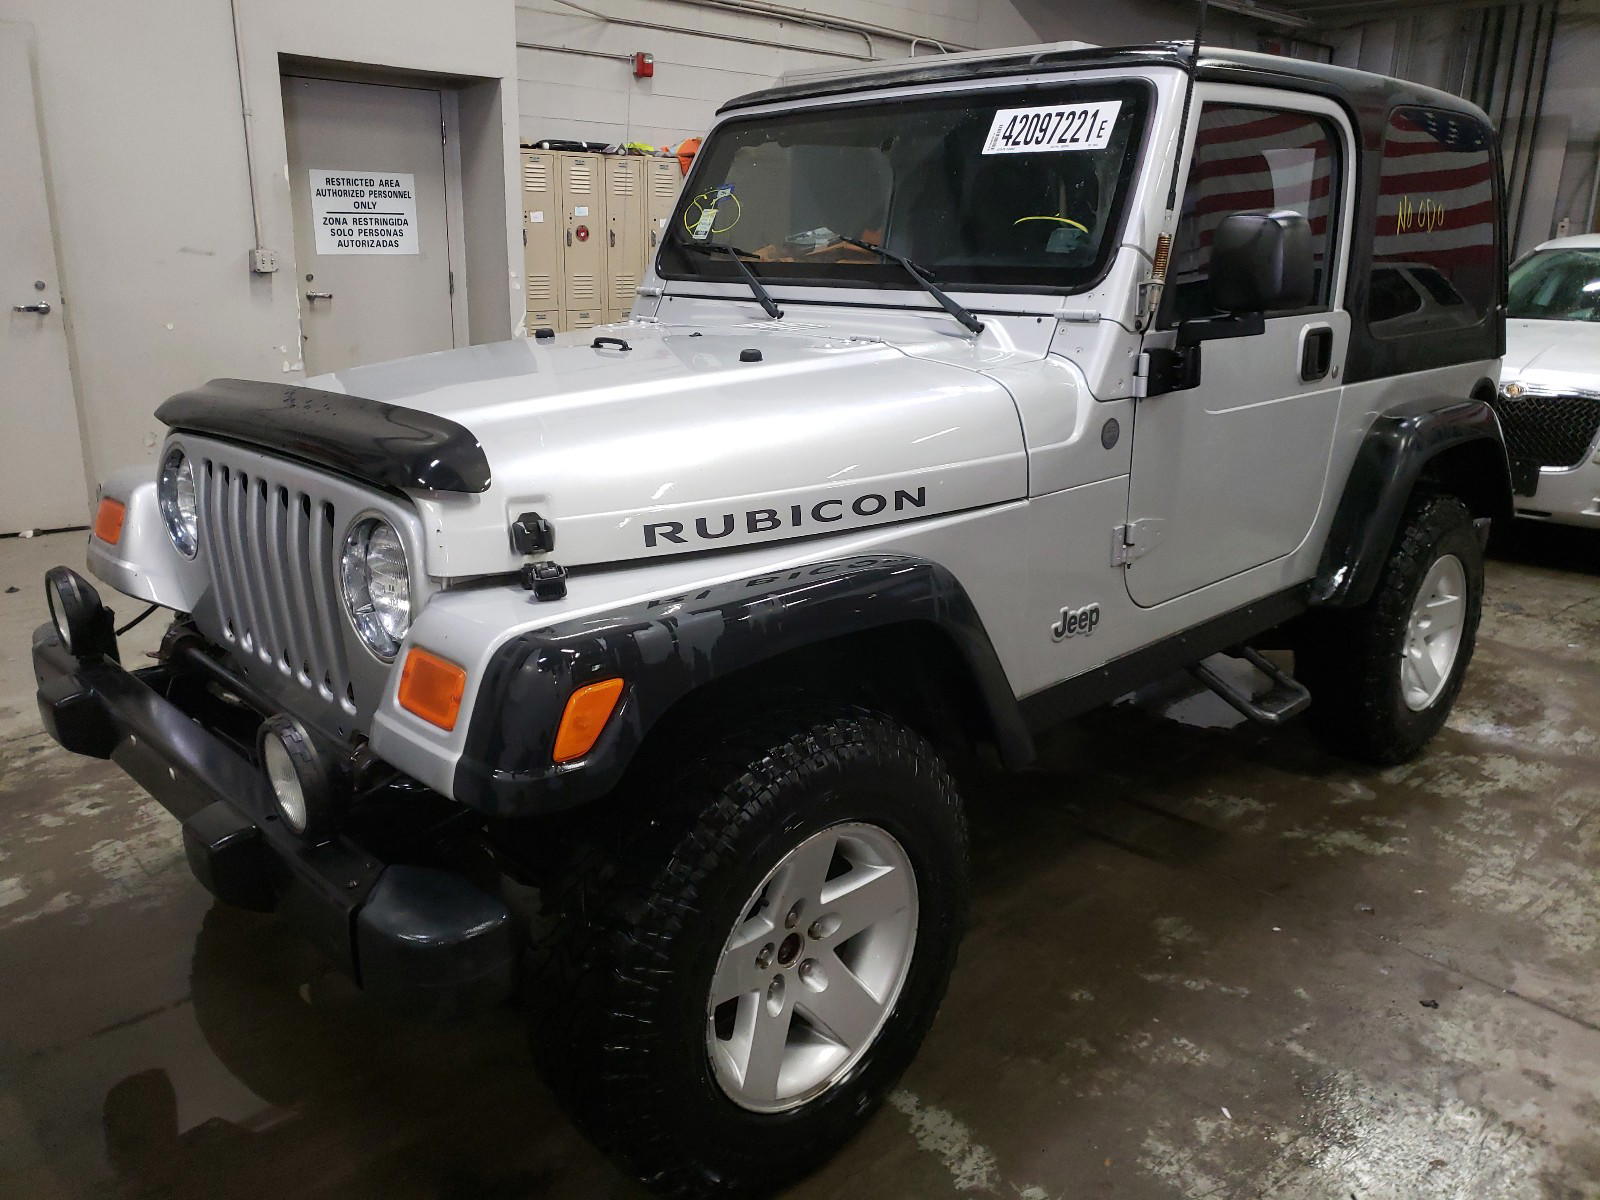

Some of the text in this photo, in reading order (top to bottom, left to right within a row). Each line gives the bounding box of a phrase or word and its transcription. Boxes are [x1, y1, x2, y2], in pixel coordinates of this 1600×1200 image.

[1001, 108, 1100, 147] 42097221
[1096, 119, 1109, 139] E
[325, 177, 401, 188] RESTRICTED AREA
[315, 188, 412, 199] AUTHORIZED PERSONNEL
[353, 201, 377, 210] ONLY
[322, 216, 409, 227] ZONA RESTRINGIDA
[330, 228, 404, 237] SOLO PERSONAS
[337, 239, 400, 248] AUTORIZADAS
[643, 486, 926, 548] RUBICON
[1051, 602, 1100, 642] Jeep
